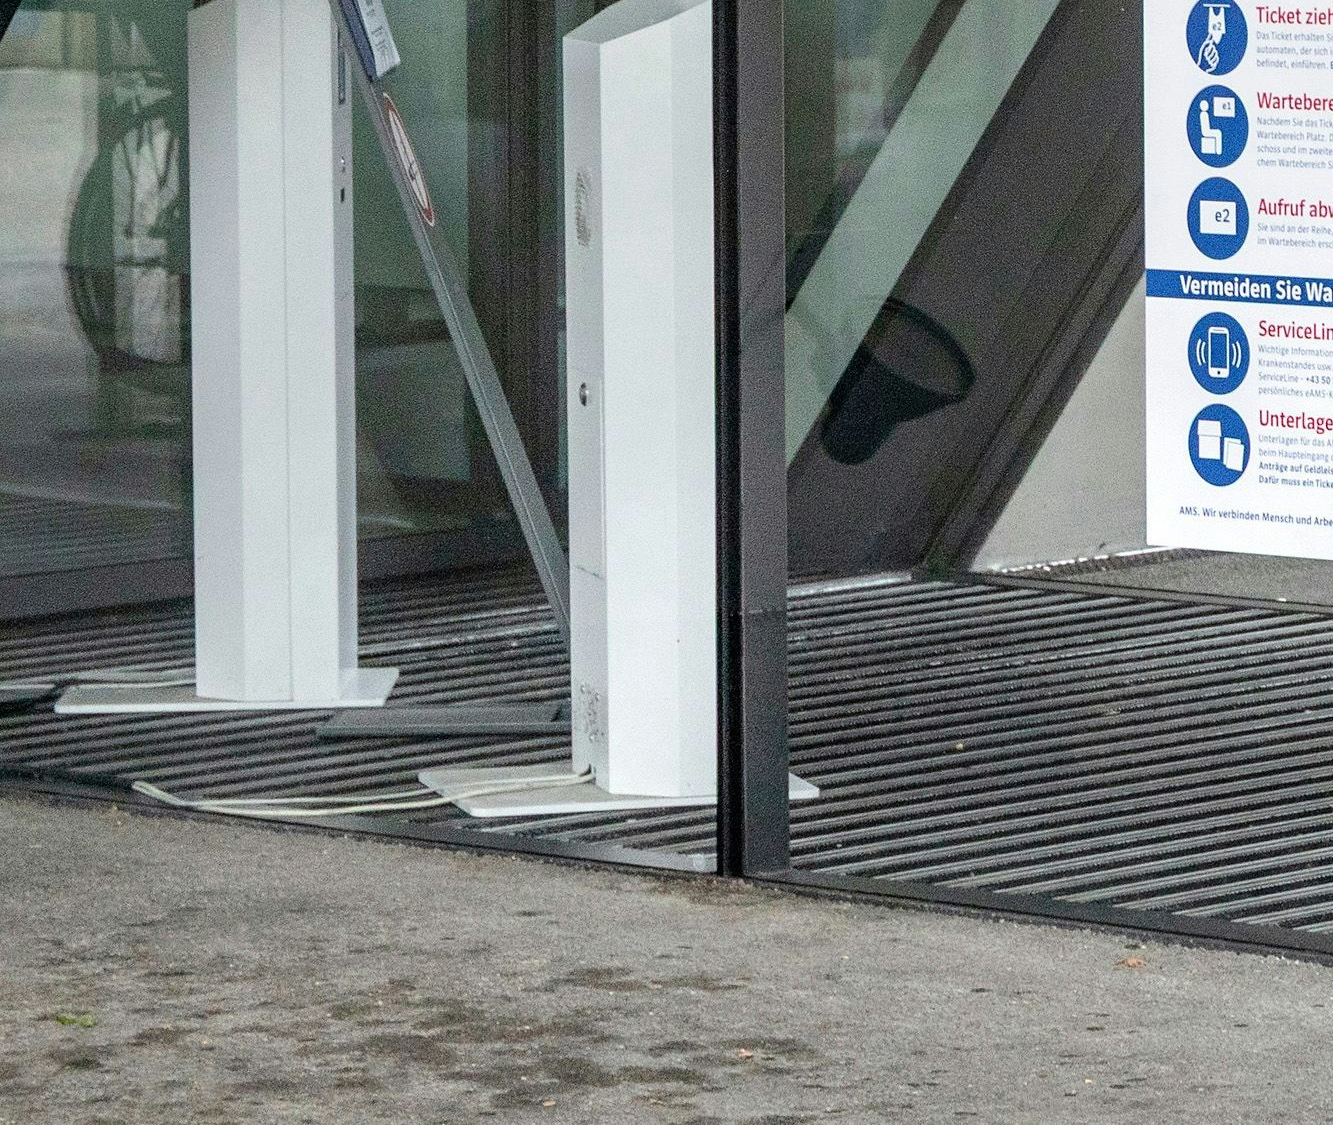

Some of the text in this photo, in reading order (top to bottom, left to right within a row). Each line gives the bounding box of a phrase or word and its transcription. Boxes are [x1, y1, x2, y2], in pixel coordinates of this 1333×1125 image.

[1256, 6, 1301, 24] Ticket
[1214, 208, 1229, 222] e2
[1258, 198, 1305, 216] Aufruf
[1180, 275, 1270, 298] Vermeiden
[1276, 280, 1301, 300] Sie
[1259, 461, 1287, 472] Anträge
[1290, 464, 1302, 472] auf
[1258, 475, 1278, 484] Dafür
[1179, 506, 1199, 515] AMS.
[1202, 508, 1216, 516] Wir
[1218, 510, 1259, 520] verbinden
[1262, 512, 1293, 523] Mensch
[1296, 516, 1311, 524] und
